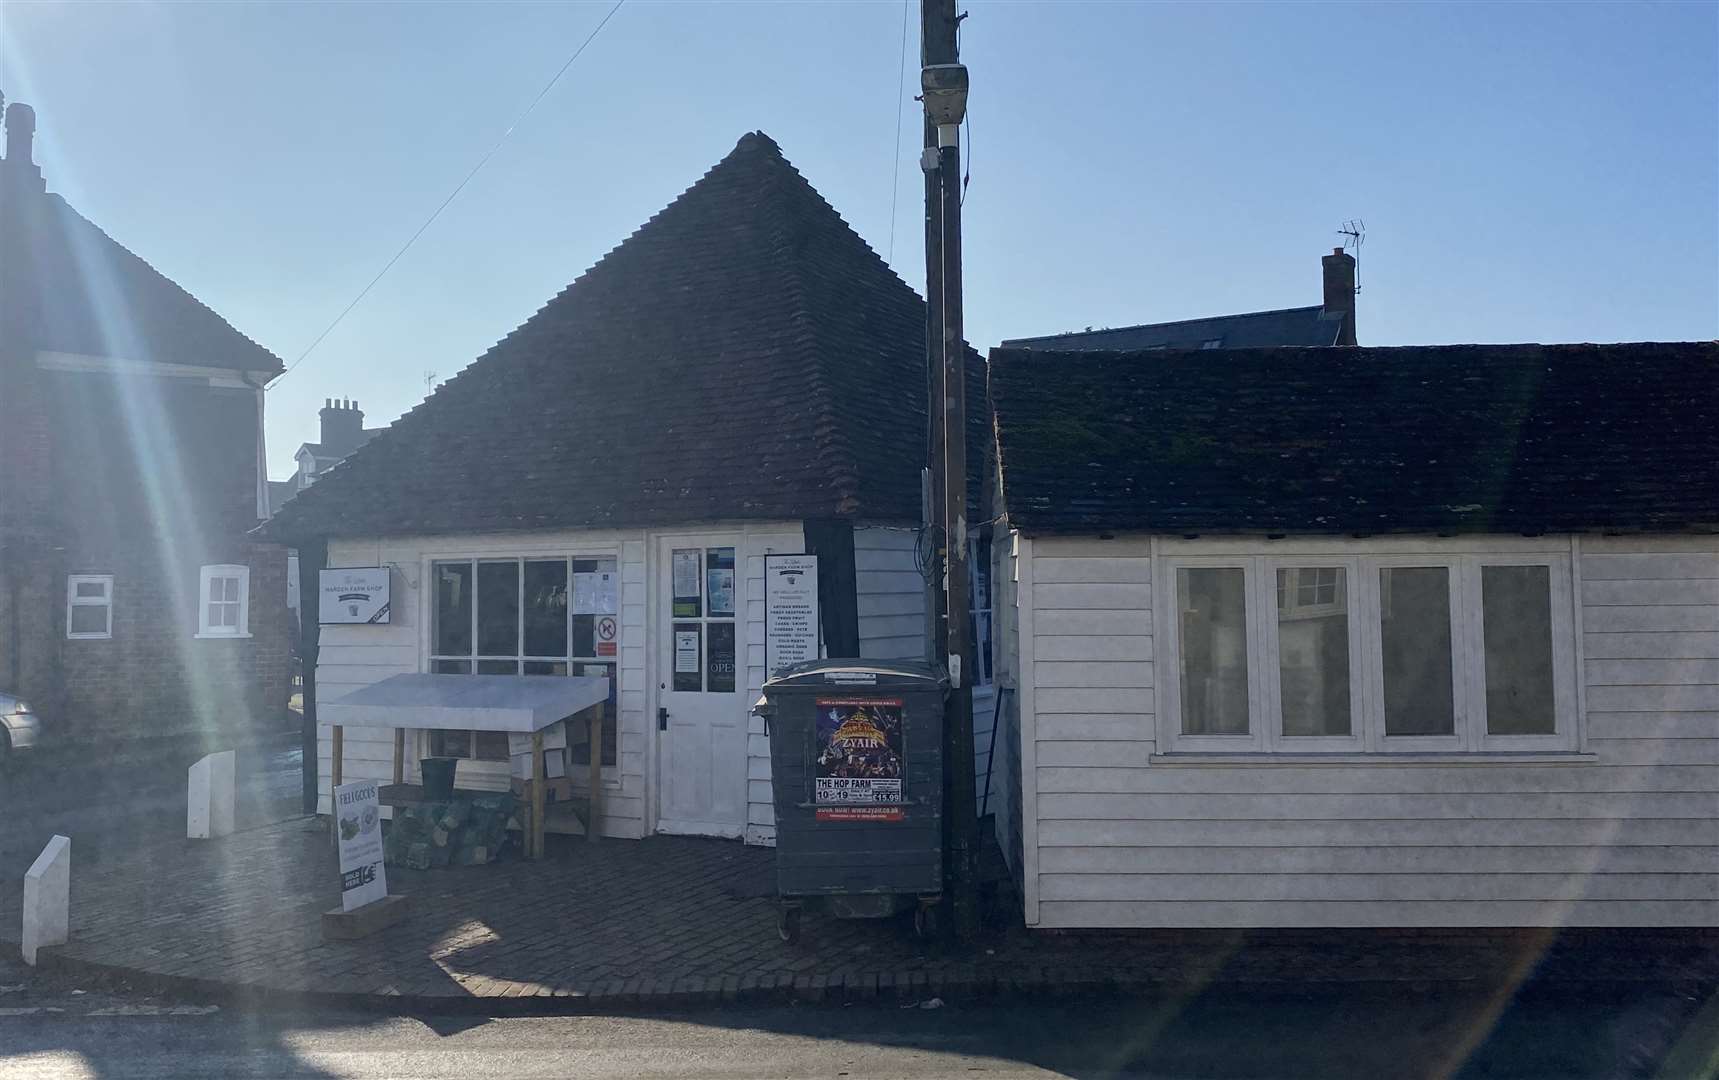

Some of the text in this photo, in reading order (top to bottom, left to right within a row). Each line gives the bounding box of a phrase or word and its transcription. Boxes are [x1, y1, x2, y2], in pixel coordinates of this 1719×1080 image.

[842, 738, 879, 749] ZYAIR
[817, 779, 833, 788] THE
[834, 779, 850, 788] HOP
[852, 779, 871, 788] FARM
[817, 791, 829, 799] 10
[836, 791, 848, 800] 19
